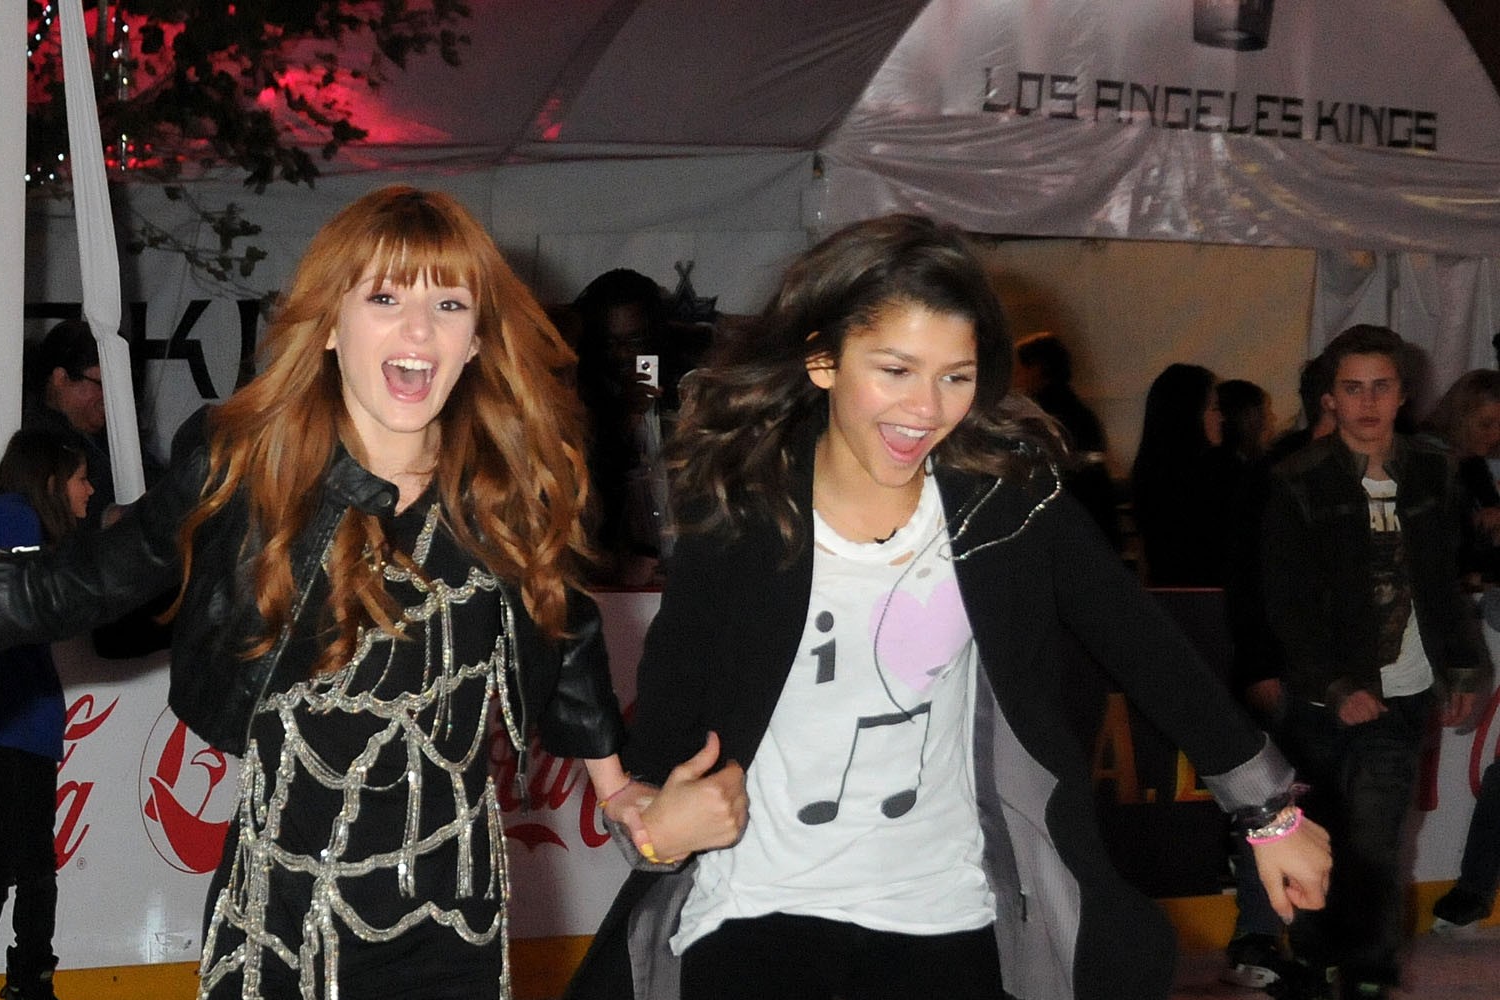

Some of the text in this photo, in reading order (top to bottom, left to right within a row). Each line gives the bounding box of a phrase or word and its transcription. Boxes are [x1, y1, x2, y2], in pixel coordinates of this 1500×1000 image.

[982, 67, 1438, 151] LOS ANGELES KINGS
